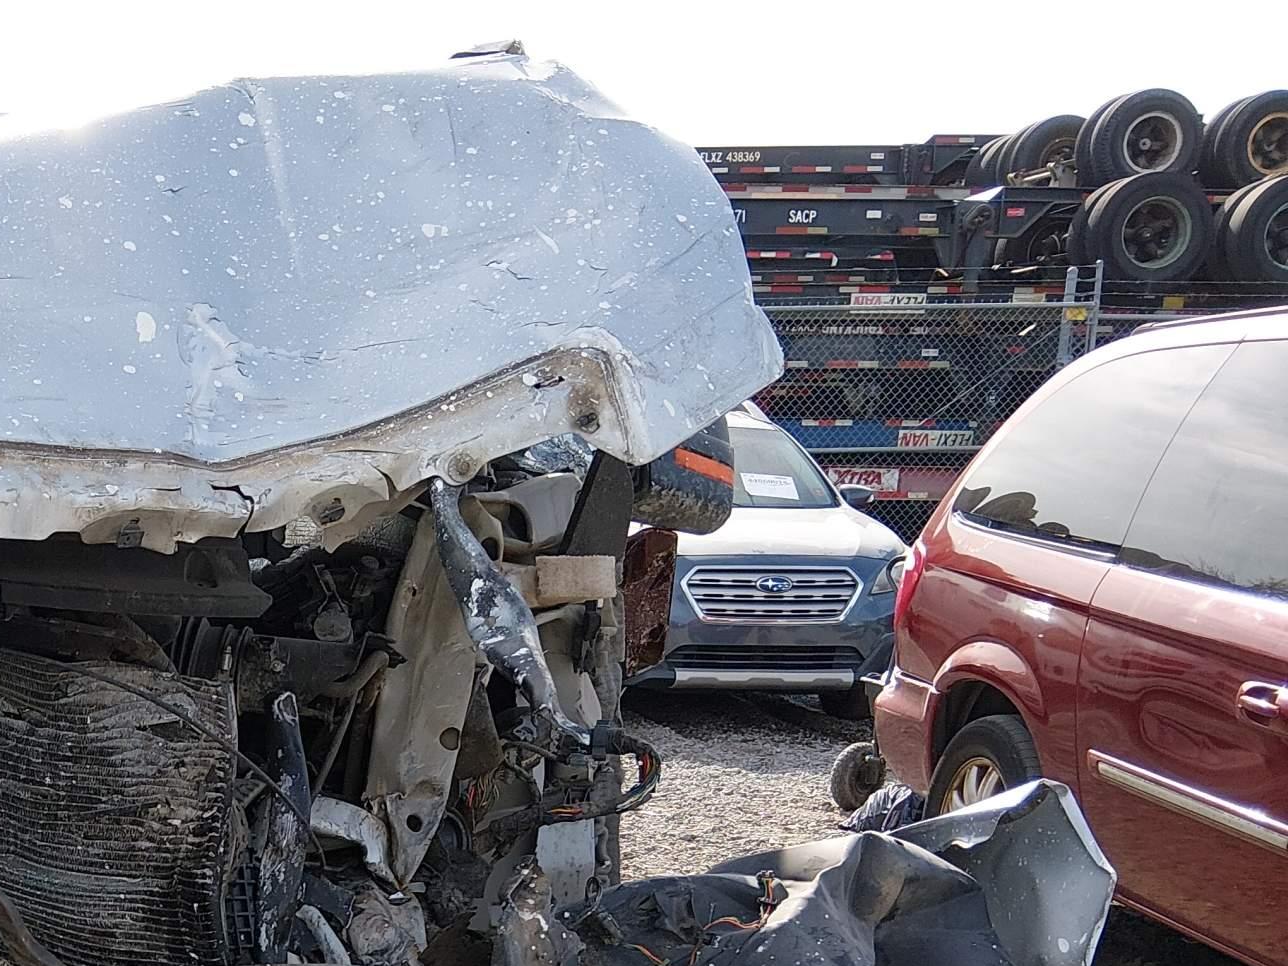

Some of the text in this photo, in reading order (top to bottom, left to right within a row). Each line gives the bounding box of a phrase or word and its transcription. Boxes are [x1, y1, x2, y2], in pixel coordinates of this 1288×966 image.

[700, 151, 761, 163] FLXZ 438369
[788, 209, 817, 224] SACP
[899, 431, 972, 447] FLEXI-VAN
